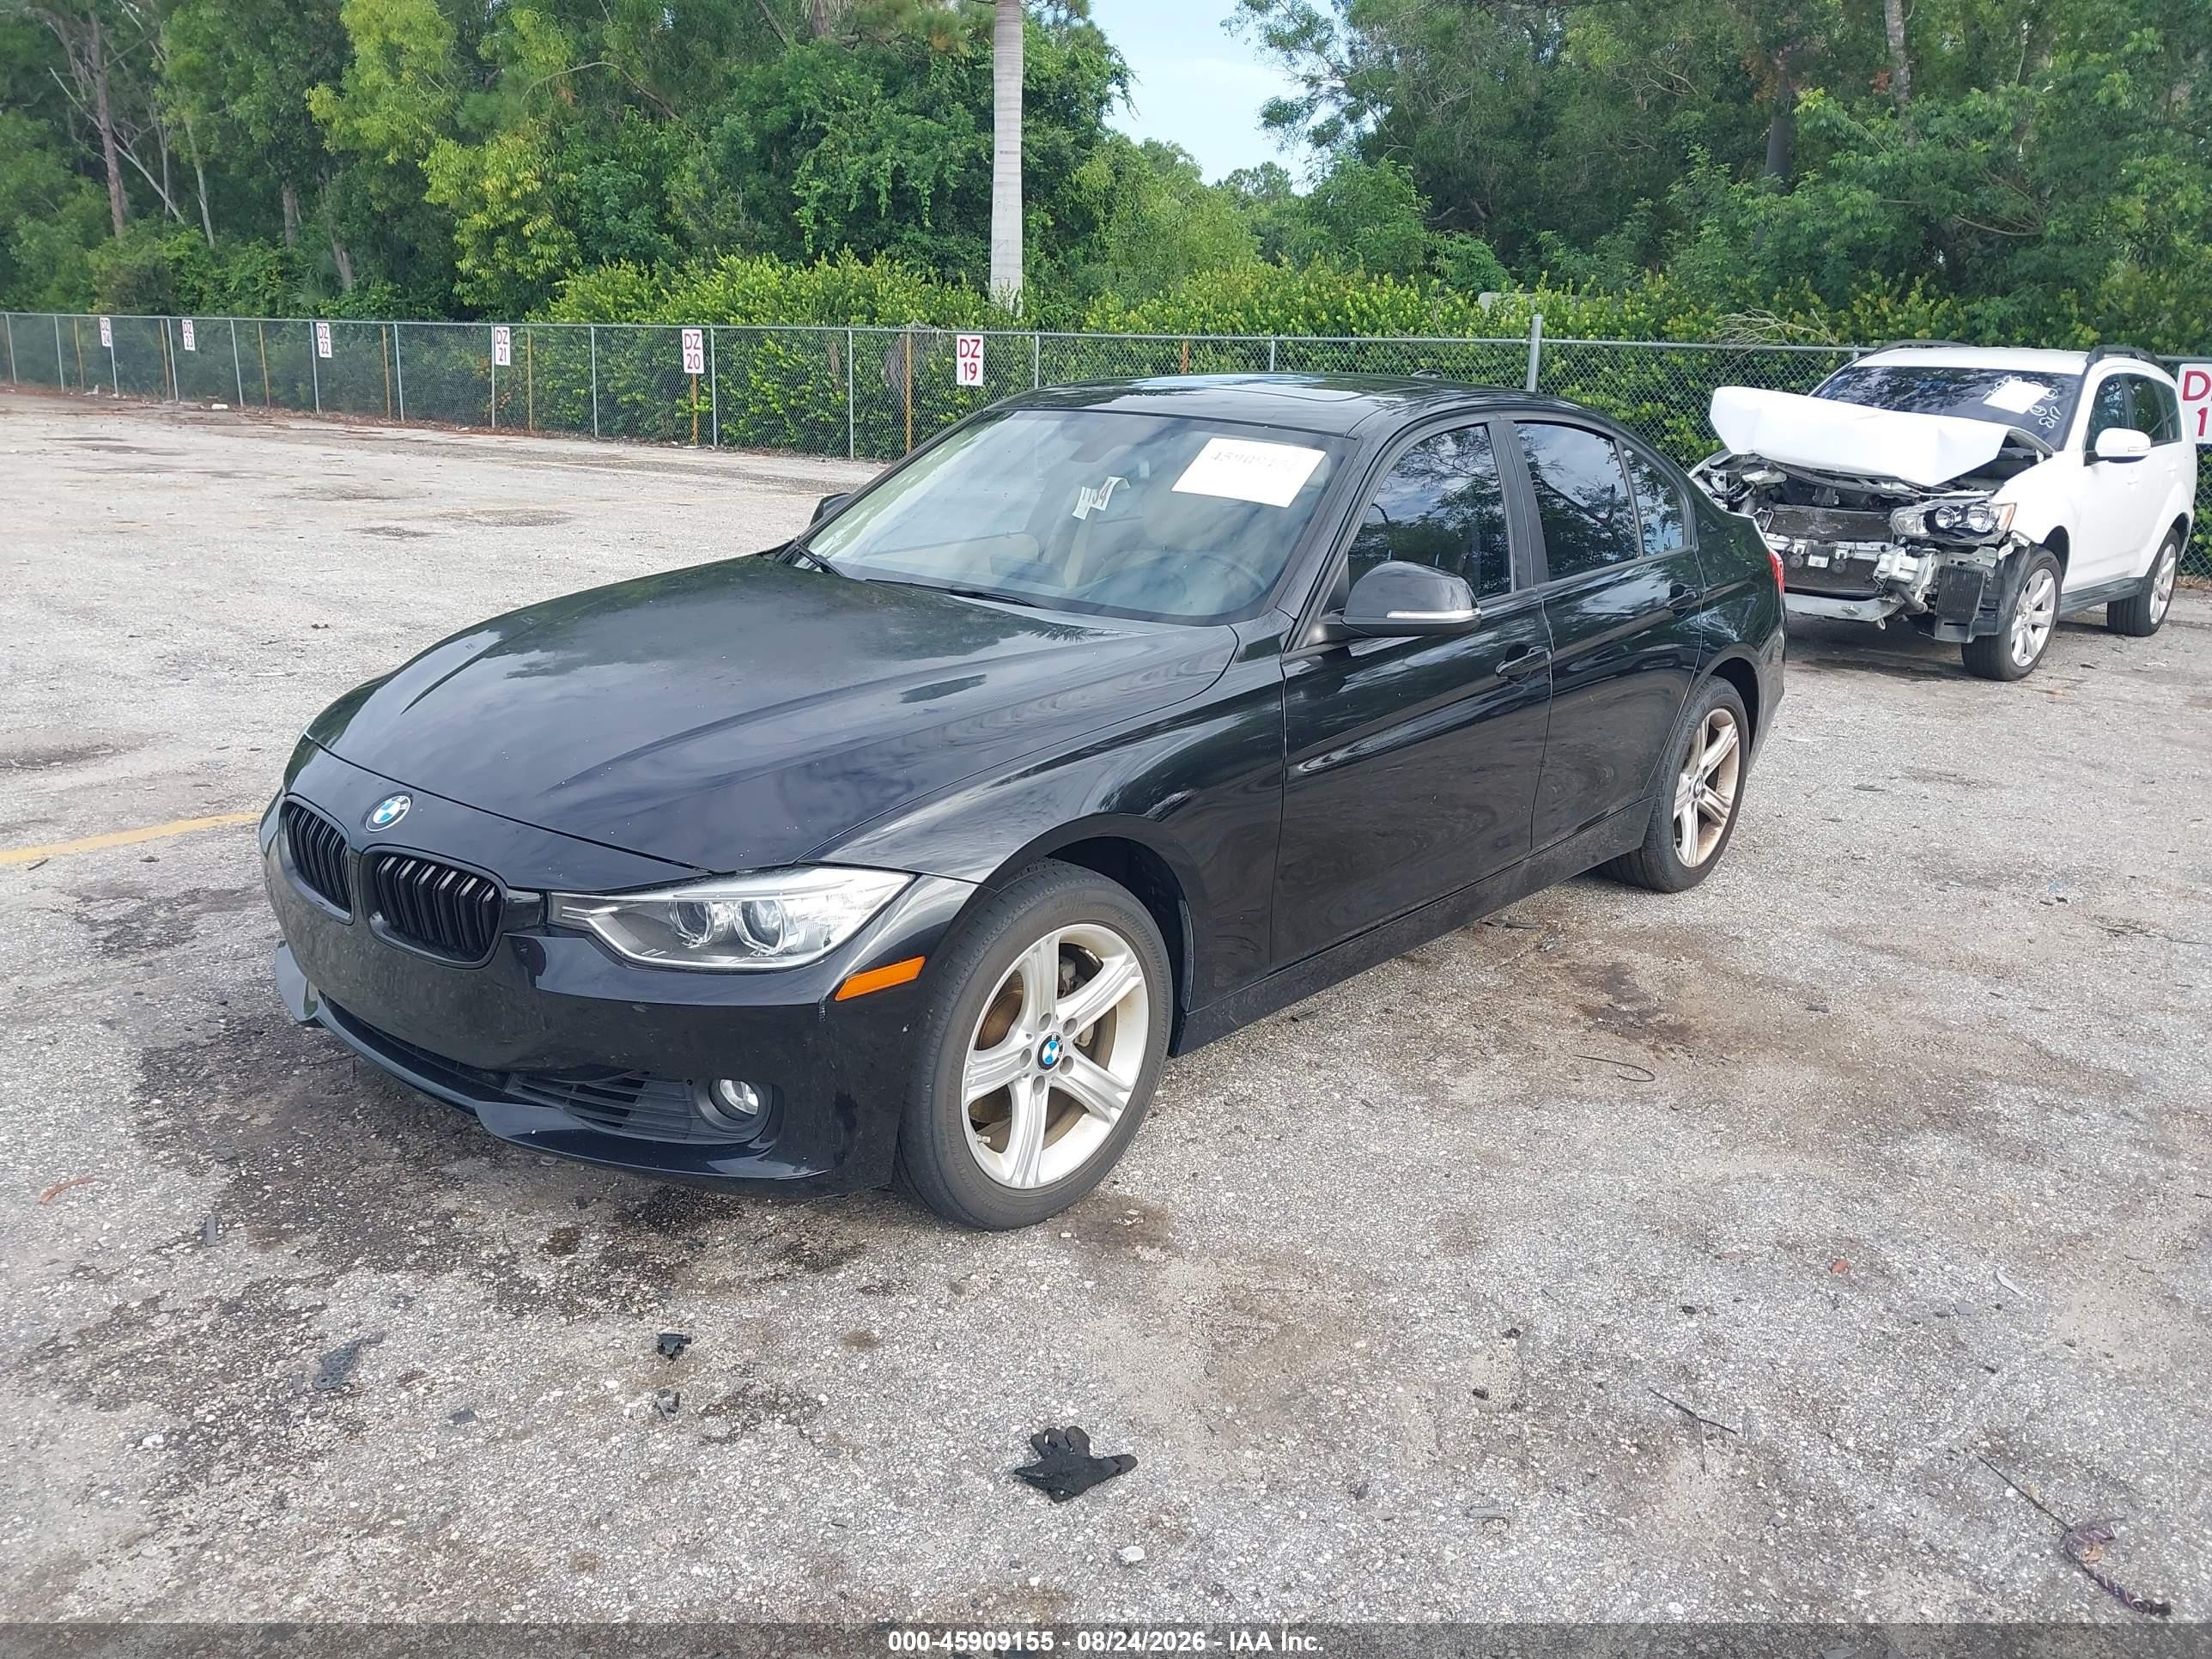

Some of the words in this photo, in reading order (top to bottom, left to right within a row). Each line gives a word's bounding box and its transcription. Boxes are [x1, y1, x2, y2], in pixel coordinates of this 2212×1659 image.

[184, 321, 192, 334] DZ
[318, 325, 329, 338] DZ
[496, 330, 508, 344] DZ
[684, 333, 701, 349] DZ
[320, 341, 329, 354] 22
[499, 347, 507, 362] 21
[959, 338, 981, 358] DZ
[687, 353, 701, 369] 20
[963, 362, 977, 380] 19
[2183, 371, 2212, 401] D
